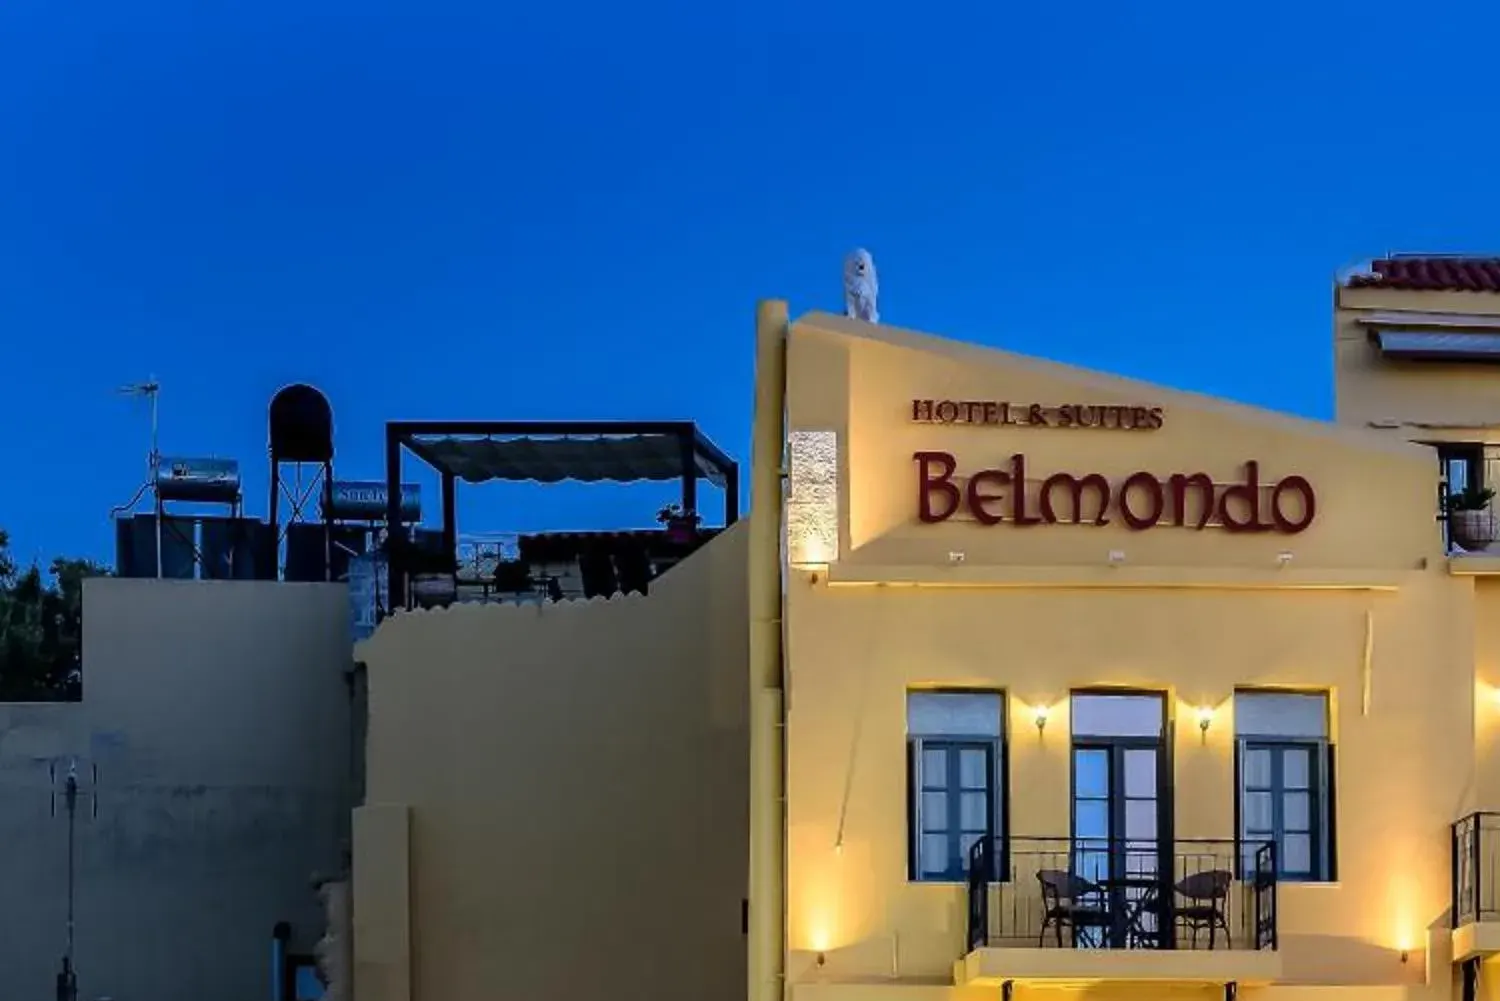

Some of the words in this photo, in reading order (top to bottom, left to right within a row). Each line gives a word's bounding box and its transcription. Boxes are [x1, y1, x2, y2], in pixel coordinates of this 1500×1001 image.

[912, 399, 1017, 426] HOTEL
[1028, 403, 1048, 426] &
[1057, 403, 1164, 430] SUITES
[912, 450, 1316, 534] Belmondo
